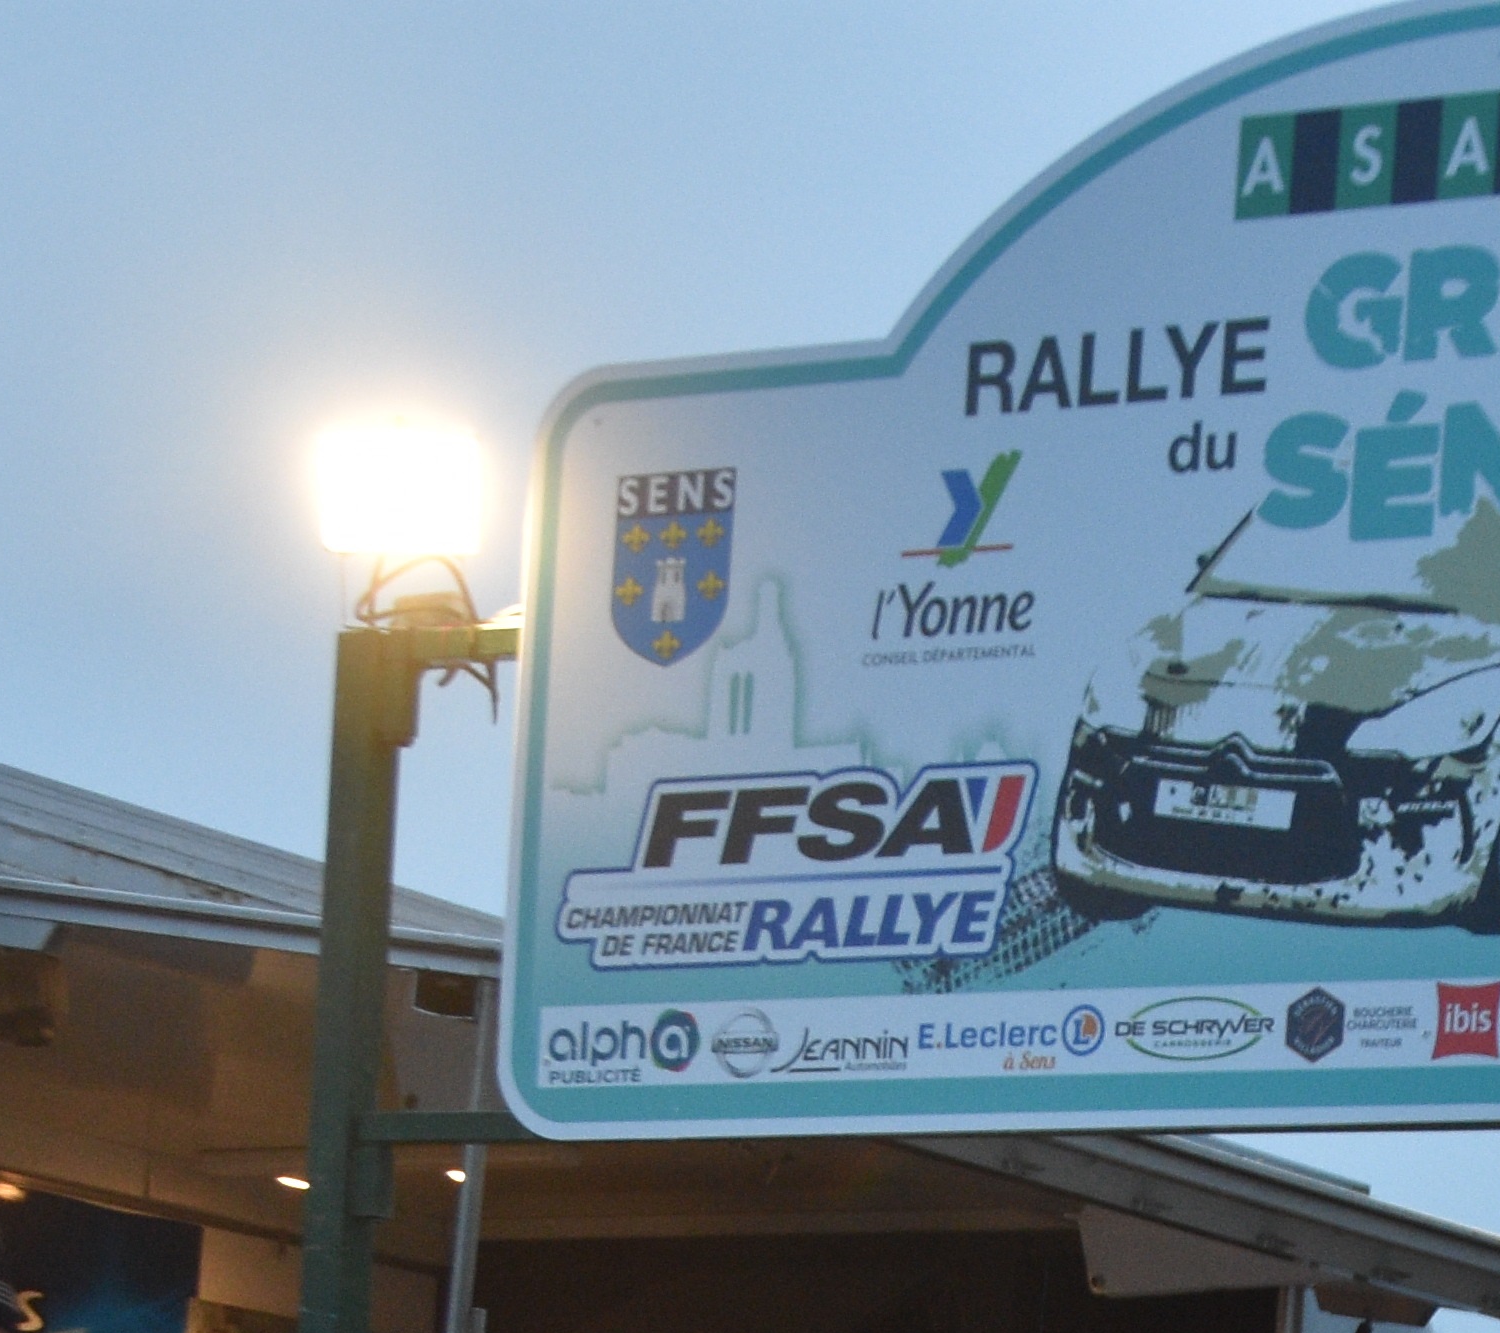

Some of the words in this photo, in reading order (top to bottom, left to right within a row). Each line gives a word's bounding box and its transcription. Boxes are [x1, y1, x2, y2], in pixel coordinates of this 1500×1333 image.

[964, 317, 1270, 417] RALLYE
[1167, 421, 1237, 476] du
[619, 469, 737, 517] SENS
[871, 582, 1036, 642] l'Yonne
[862, 650, 917, 667] CONSEIL
[922, 643, 1037, 665] DÉPARTEMENTAL
[642, 777, 982, 868] FFSA
[565, 899, 749, 931] CHAMPIONNAT
[741, 889, 996, 953] RALLYE
[602, 934, 637, 957] DE
[641, 929, 740, 957] FRANCE
[1115, 1019, 1146, 1038] DE
[1444, 1002, 1493, 1035] ibis
[713, 1035, 779, 1054] NISSAN
[917, 1021, 1059, 1052] E.Leclerc
[549, 1066, 641, 1085] PUBLICITÉ
[1018, 1051, 1057, 1072] Sens
